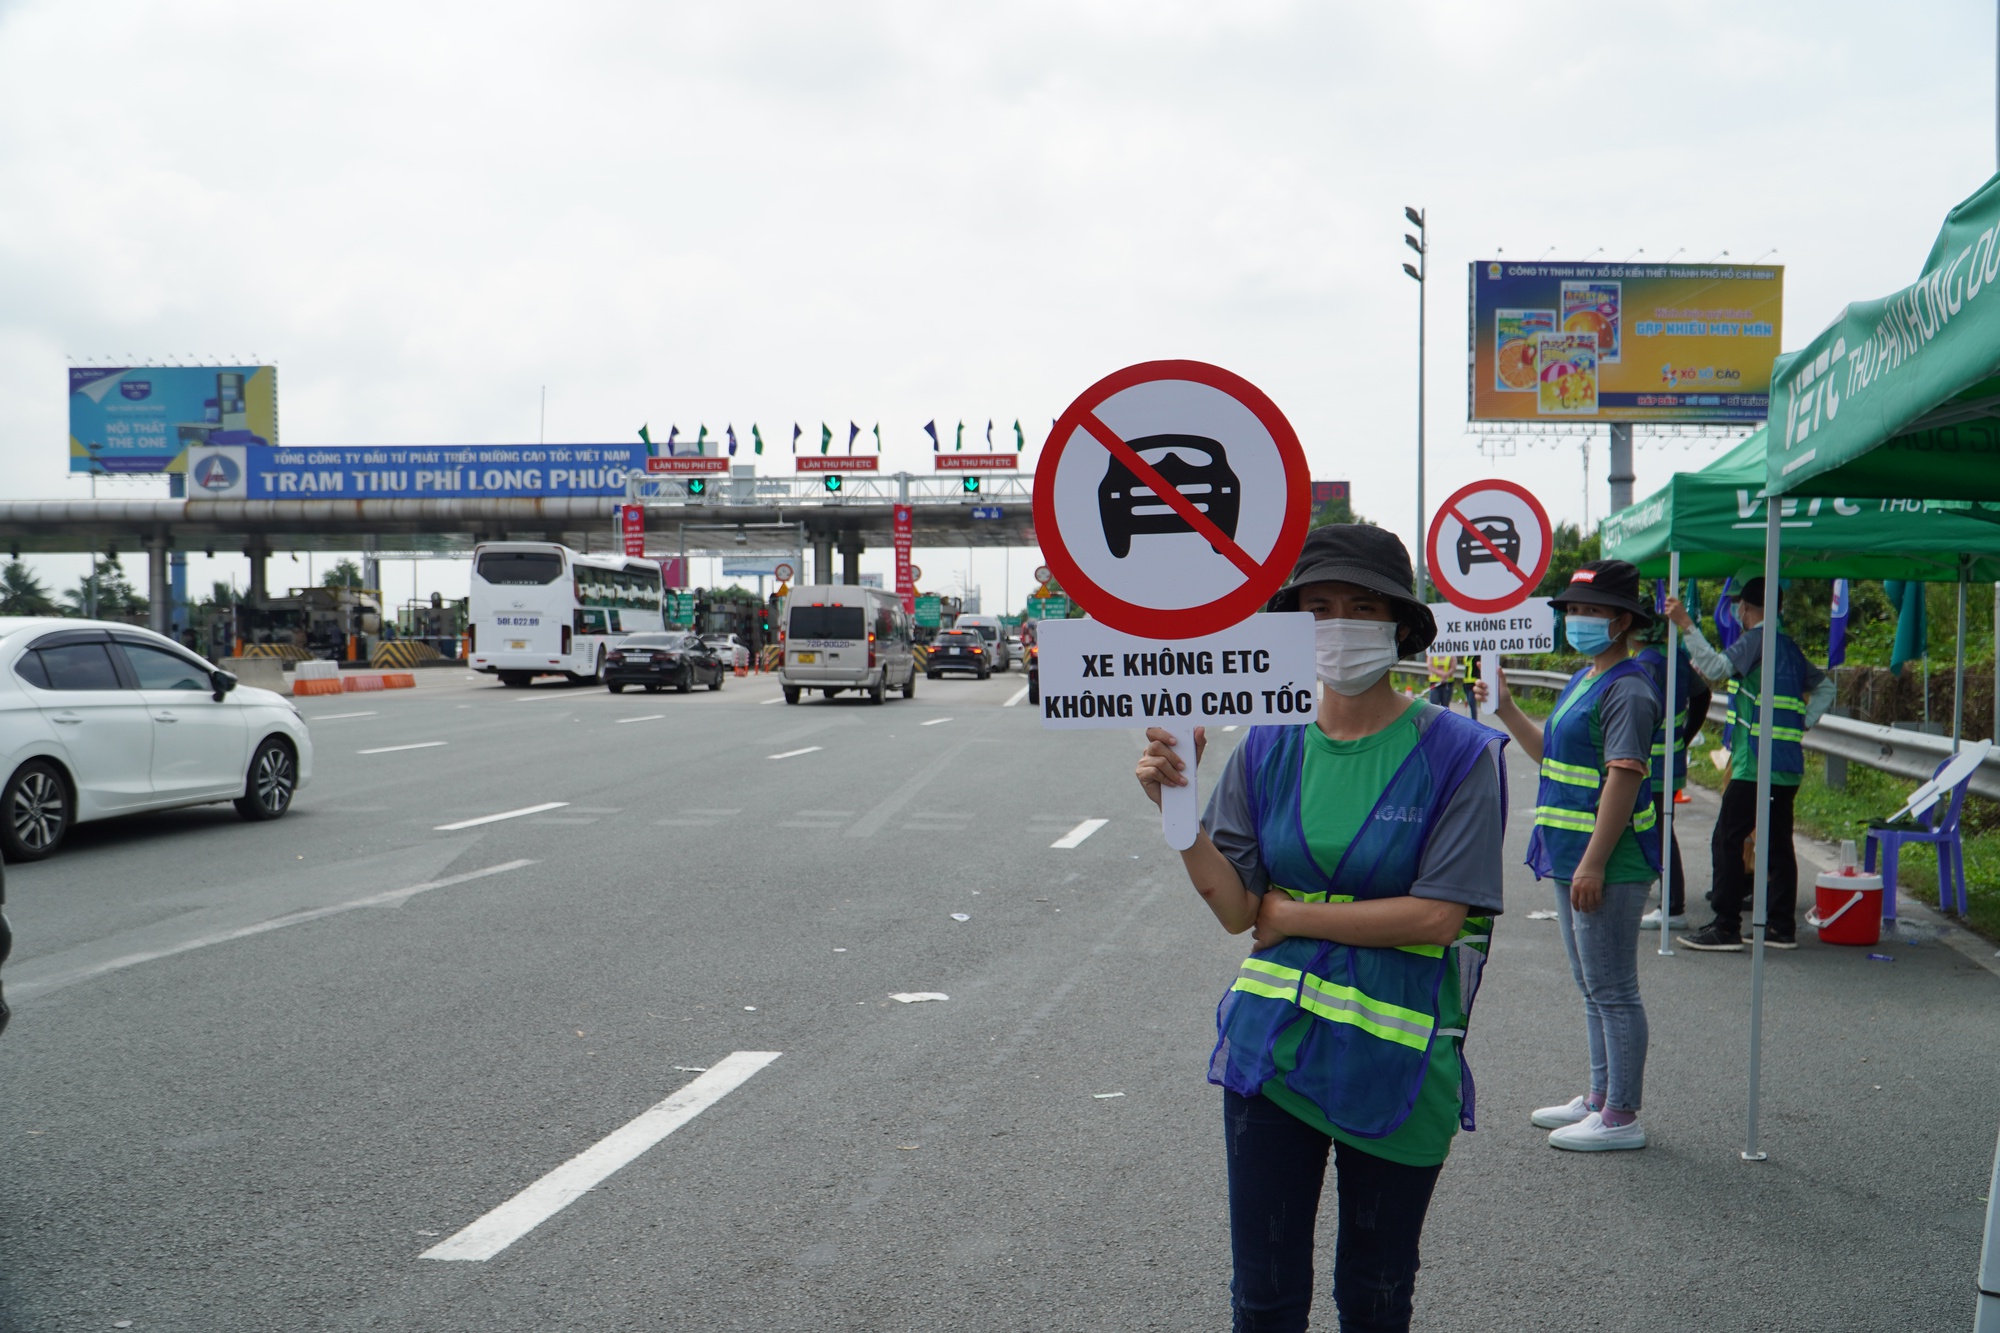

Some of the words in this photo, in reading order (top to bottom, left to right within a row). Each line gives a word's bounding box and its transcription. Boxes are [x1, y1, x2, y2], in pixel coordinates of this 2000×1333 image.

[1508, 266, 1537, 277] CÔNG
[1538, 267, 1549, 277] TY
[1550, 267, 1575, 277] TNHH
[1576, 267, 1595, 278] MTV
[1611, 265, 1624, 278] SỐ
[1625, 266, 1645, 278] KIẾN
[1646, 265, 1667, 279] THIẾT
[1669, 268, 1700, 279] THÀNH
[1701, 267, 1720, 280] PHỐ
[1721, 267, 1735, 280] HỒ
[1735, 269, 1752, 280] CHÍ
[1752, 270, 1775, 280] MINH
[1709, 322, 1740, 337] MAY
[1716, 367, 1741, 380] CÀO
[1846, 333, 1879, 400] THU
[106, 421, 130, 436] NỘI
[132, 420, 166, 434] THẤT
[107, 437, 134, 448] THE
[137, 437, 167, 448] ONE
[274, 448, 305, 465] TỔNG
[308, 451, 341, 465] CÔNG
[345, 452, 360, 464] TY
[364, 449, 387, 464] ĐẦU
[391, 451, 407, 463] TƯ
[410, 451, 439, 464] PHÁT
[444, 448, 477, 463] TRIỂN
[480, 448, 519, 463] ĐƯỜNG
[522, 451, 546, 463] CAO
[550, 448, 572, 463] TỐC
[575, 448, 600, 465] VIỆT
[604, 450, 630, 462] NAM
[803, 459, 821, 469] LÀN
[822, 460, 838, 469] THU
[840, 459, 855, 469] PHÍ
[856, 459, 872, 469] ETC
[942, 458, 960, 467] LÀN
[961, 458, 978, 467] THU
[980, 457, 994, 467] PHÍ
[995, 458, 1011, 467] ETC
[653, 461, 672, 470] LÀN
[673, 461, 690, 470] THU
[691, 460, 706, 470] PHÍ
[707, 461, 723, 470] ETC
[260, 472, 343, 496] TRẠM
[352, 471, 408, 492] THU
[415, 465, 464, 491] PHÍ
[468, 469, 542, 491] LONG
[1446, 621, 1461, 633] XE
[1465, 618, 1506, 632] KHÔNG
[1510, 618, 1532, 630] ETC
[1429, 638, 1470, 654] KHÔNG
[1473, 636, 1496, 651] VÀO
[1500, 638, 1524, 650] CAO
[1528, 633, 1551, 649] TỐC
[1082, 654, 1115, 677] XE
[1123, 647, 1214, 677] KHÔNG
[1222, 649, 1270, 674] ETC
[1045, 690, 1133, 719] KHÔNG
[1141, 688, 1193, 717] VÀO
[1201, 691, 1253, 716] CAO
[1262, 681, 1312, 714] TỐC
